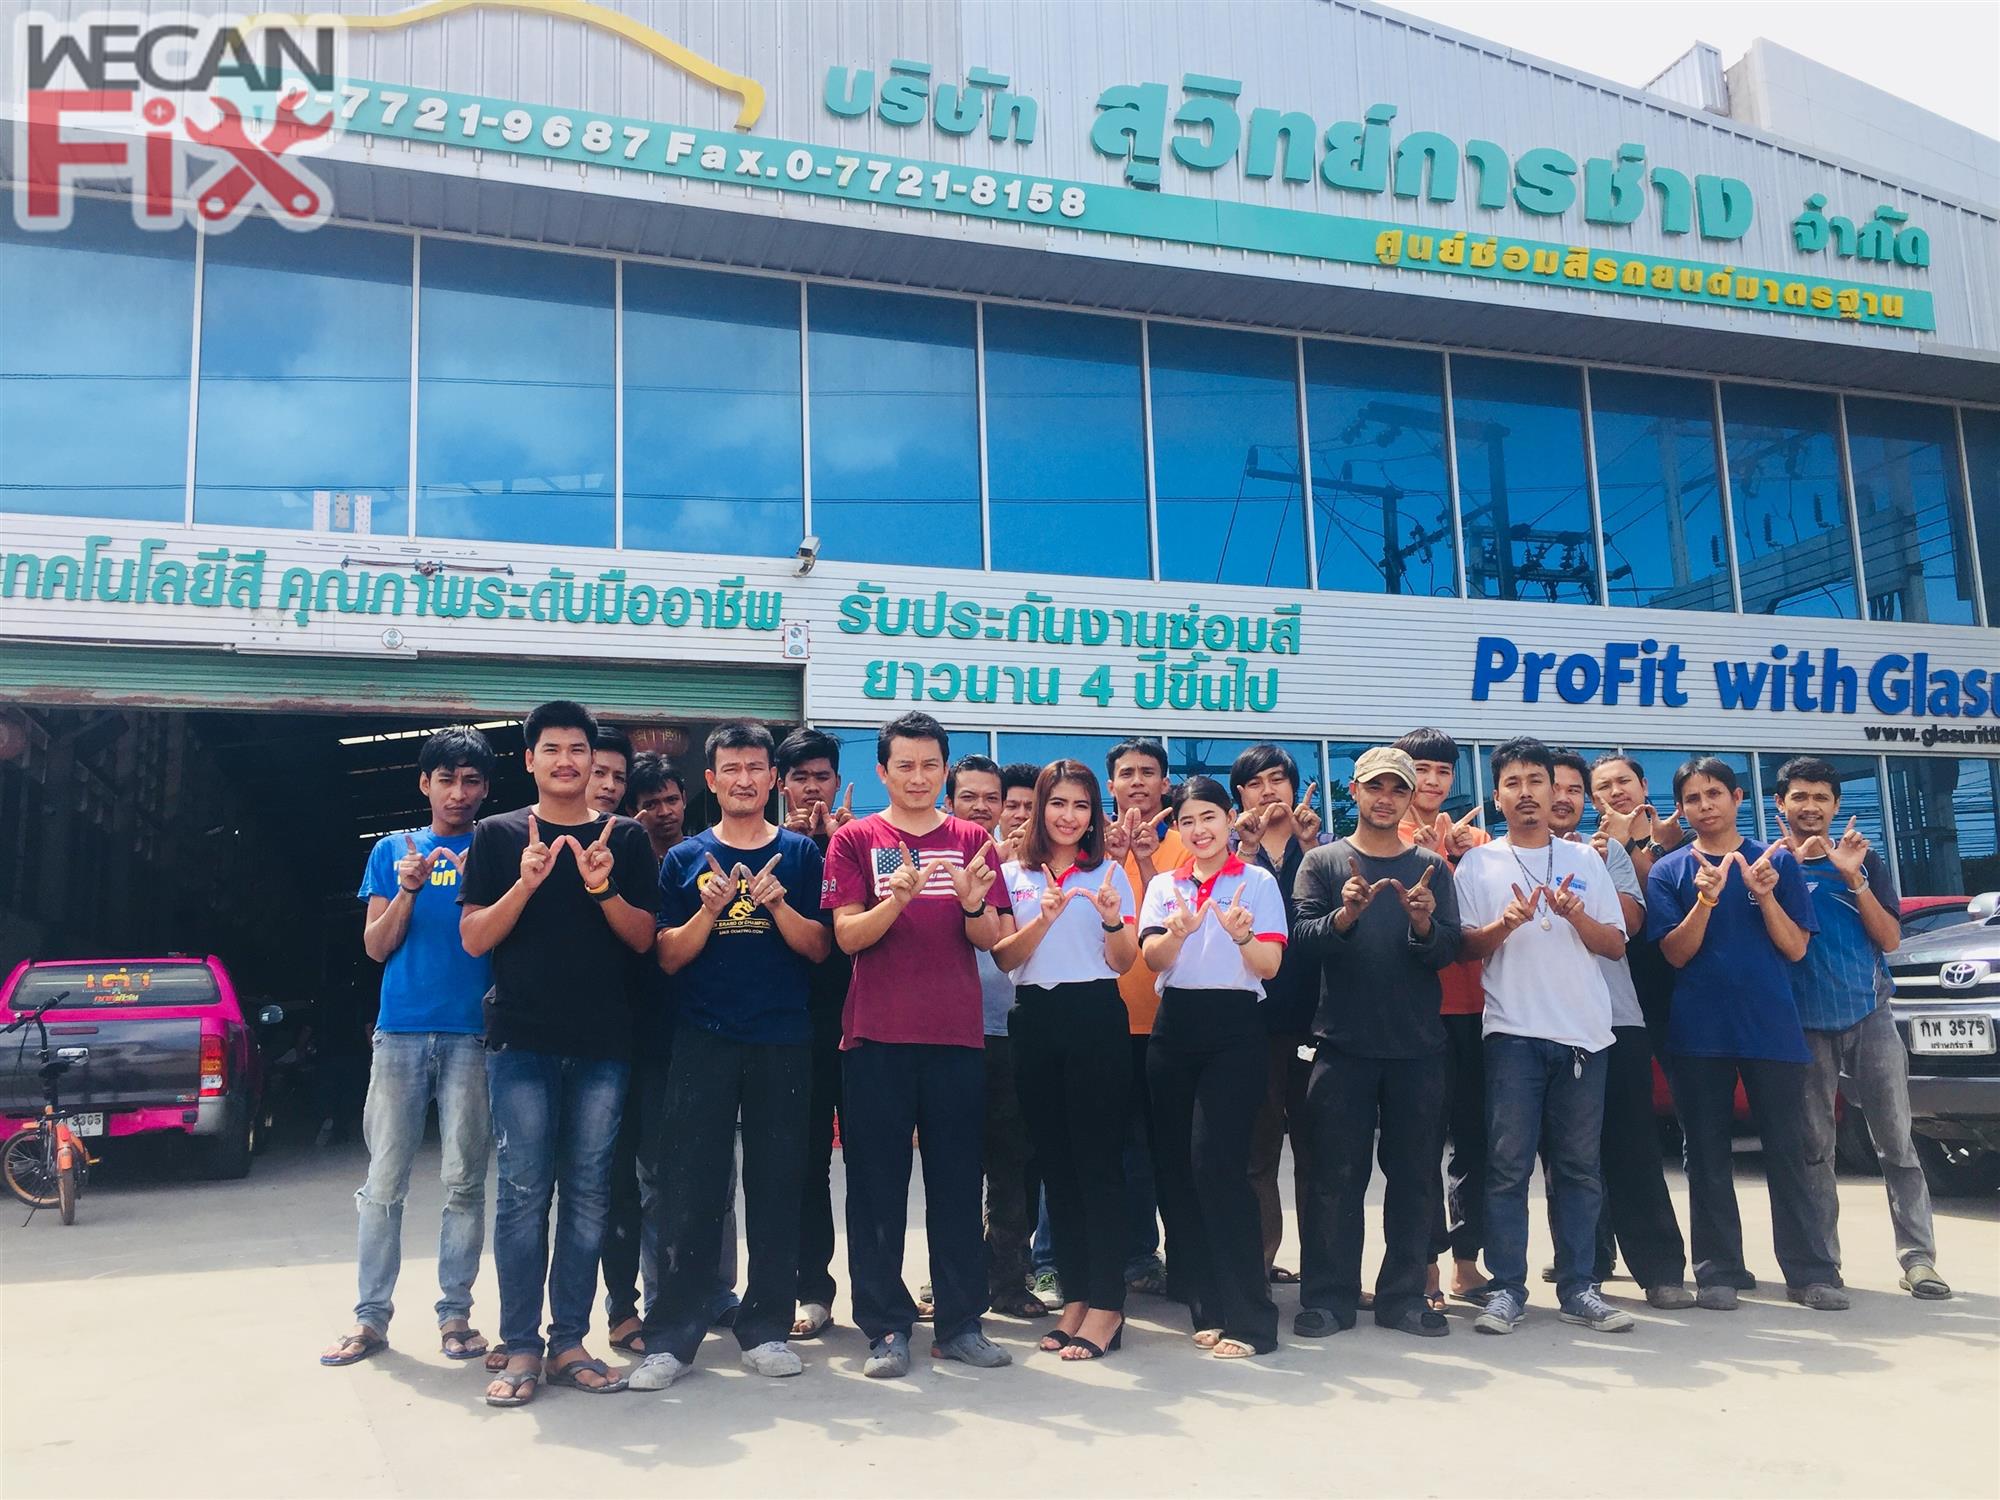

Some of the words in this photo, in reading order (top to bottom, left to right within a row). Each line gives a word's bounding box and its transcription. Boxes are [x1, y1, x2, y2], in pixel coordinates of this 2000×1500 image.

[824, 59, 1038, 145] บริษัท
[1091, 73, 1755, 240] สุวิทย์การช่าง
[1792, 192, 1930, 268] จำกัด
[1375, 230, 1904, 318] ศูนย์ซ่อมสีรถยนต์มาตรฐาน
[0, 535, 266, 609] ทคโนโลยีสี
[278, 567, 782, 631] คุณภาพระดับมืออาชีพ
[837, 581, 1302, 654] รับประกันงานซ่อมสี
[863, 660, 1060, 705] ยาวนาน
[1080, 664, 1114, 708] 4
[1134, 650, 1279, 712] ปีขึ้นไป
[1471, 637, 1688, 706] ProFit
[1714, 644, 1858, 714] with
[1868, 652, 2000, 718] Glas
[1920, 1020, 1942, 1037] กพ
[1949, 1020, 1985, 1036] 3575
